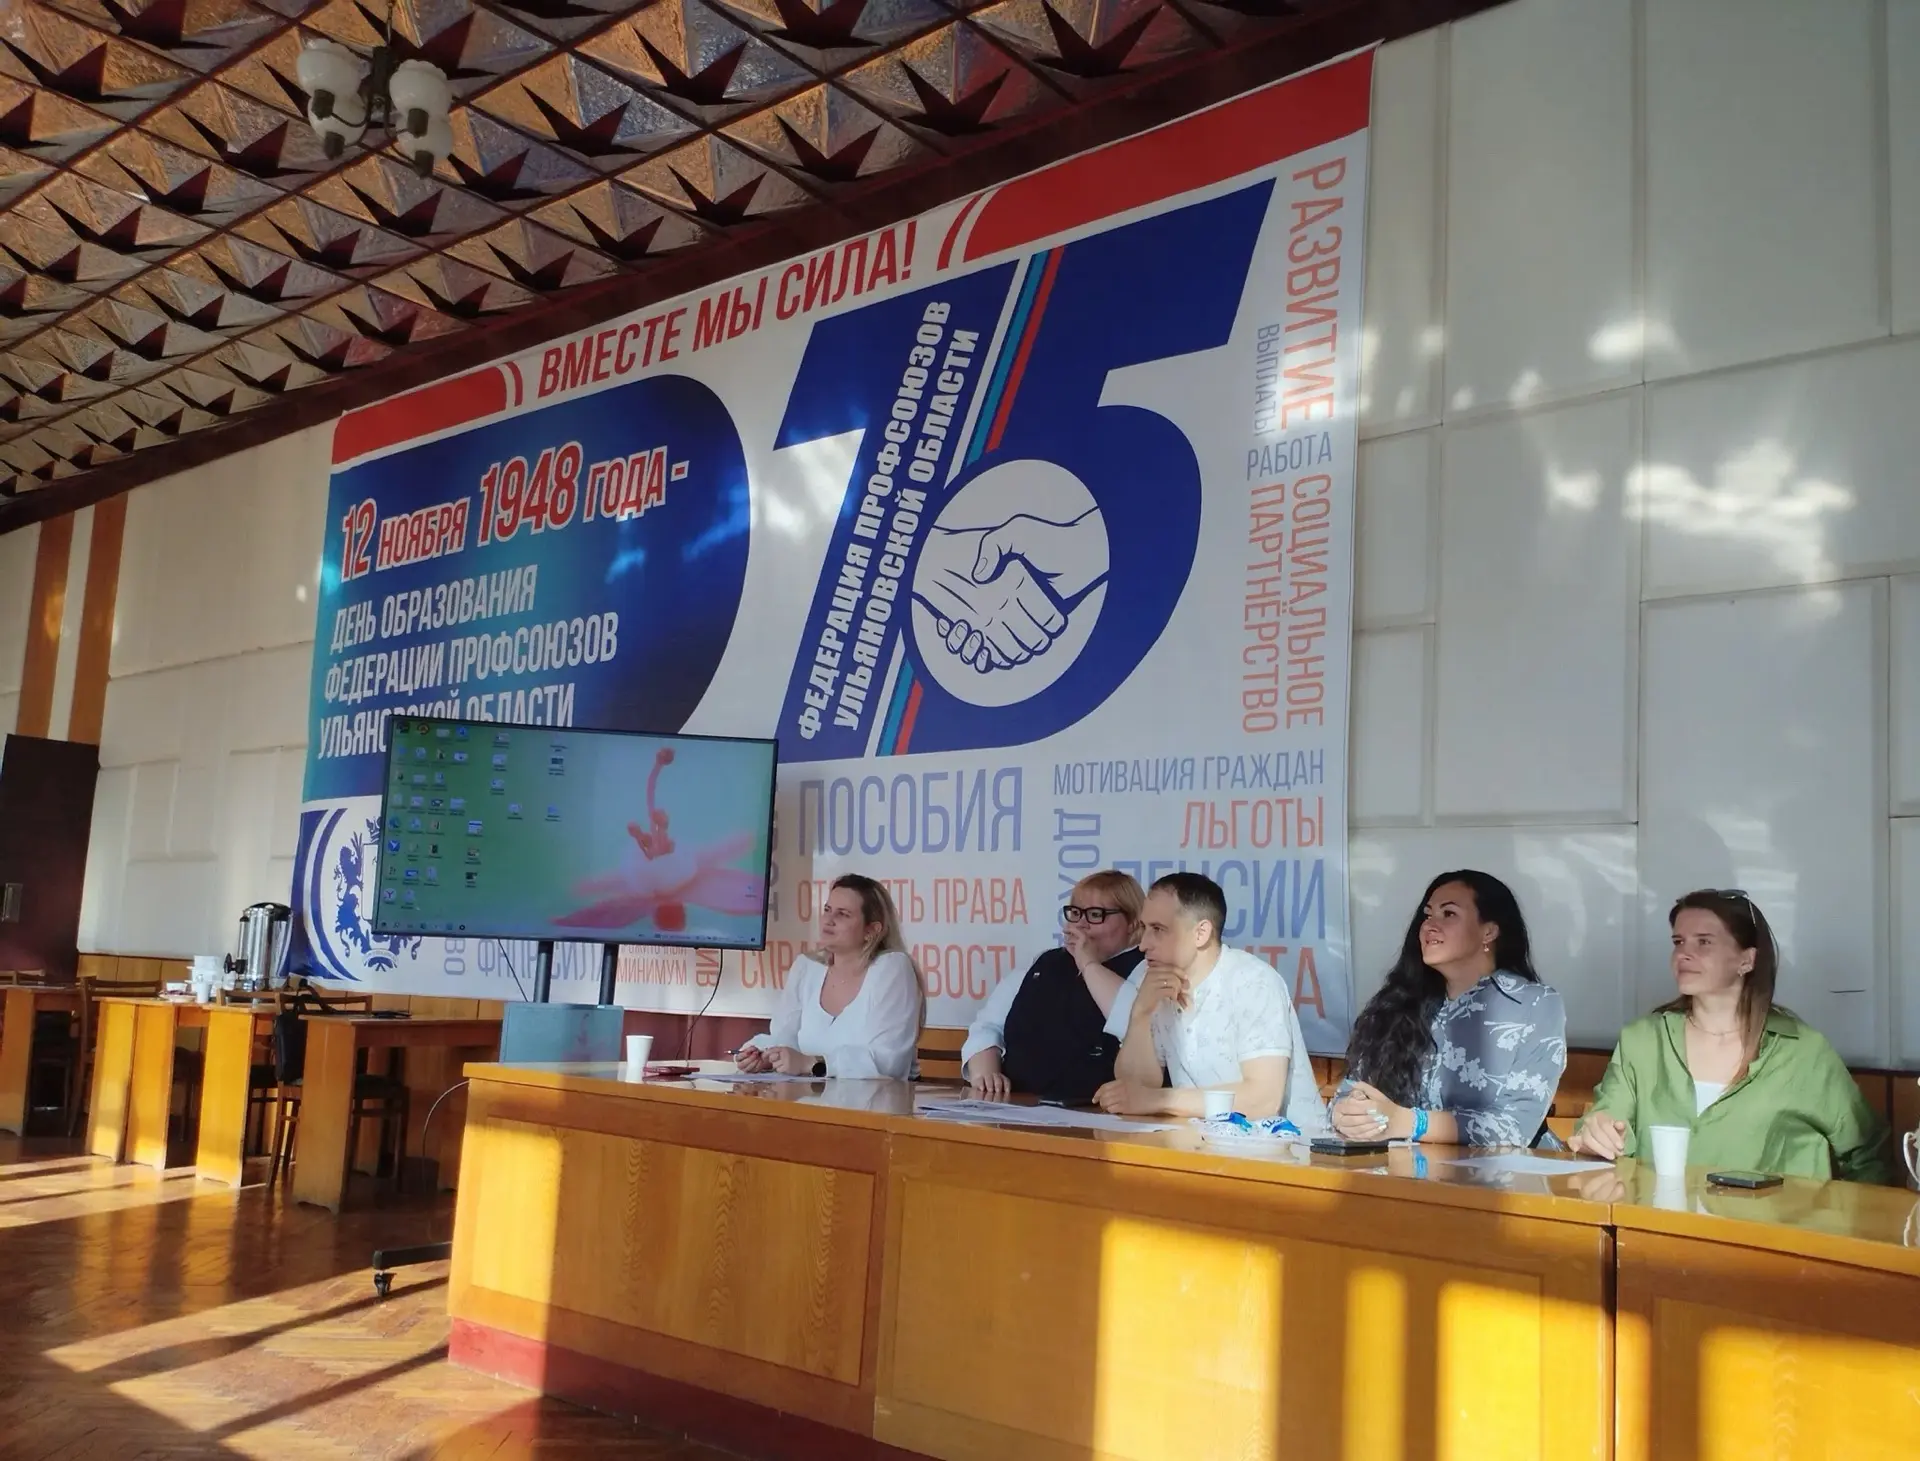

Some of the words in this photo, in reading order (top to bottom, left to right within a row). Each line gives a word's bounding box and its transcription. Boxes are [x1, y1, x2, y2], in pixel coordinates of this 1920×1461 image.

[537, 308, 688, 398] ВМЕСТЕ
[692, 277, 768, 352] МЫ
[775, 221, 917, 321] СИЛА!
[1281, 156, 1347, 430] РАЗВИТИЕ
[1252, 323, 1280, 437] ВЫПЛАТЫ
[1246, 431, 1333, 481] РАБОТА
[341, 498, 377, 582] 12
[376, 497, 471, 571] НОЯБРЯ
[477, 441, 583, 547] 1948
[583, 445, 667, 522] ГОДА
[798, 543, 873, 740] ФЕДЕРАЦИЯ
[853, 300, 951, 541] ПРОФСОЮЗОВ
[833, 487, 928, 731] УЛЬЯНОВСКОЙ
[908, 328, 980, 484] ОБЛАСТИ
[330, 600, 376, 654] ДЕНЬ
[380, 564, 538, 639] ОБРАЗОВАНИЯ
[1242, 482, 1288, 733] ПАРТНЁРСТВО
[1285, 473, 1332, 730] СОЦИАЛЬНОЕ
[324, 641, 445, 705] ФЕДЕРАЦИИ
[447, 611, 619, 685] ПРОФСОЮЗОВ
[799, 766, 1024, 856] ПОСОБИЯ
[1053, 757, 1195, 795] МОТИВАЦИЯ
[1203, 748, 1325, 791] ГРАЖДАН
[1179, 796, 1325, 850] ЛЬГОТЫ
[933, 877, 1030, 925] ПРАВА
[617, 957, 687, 986] МИНИМУМ
